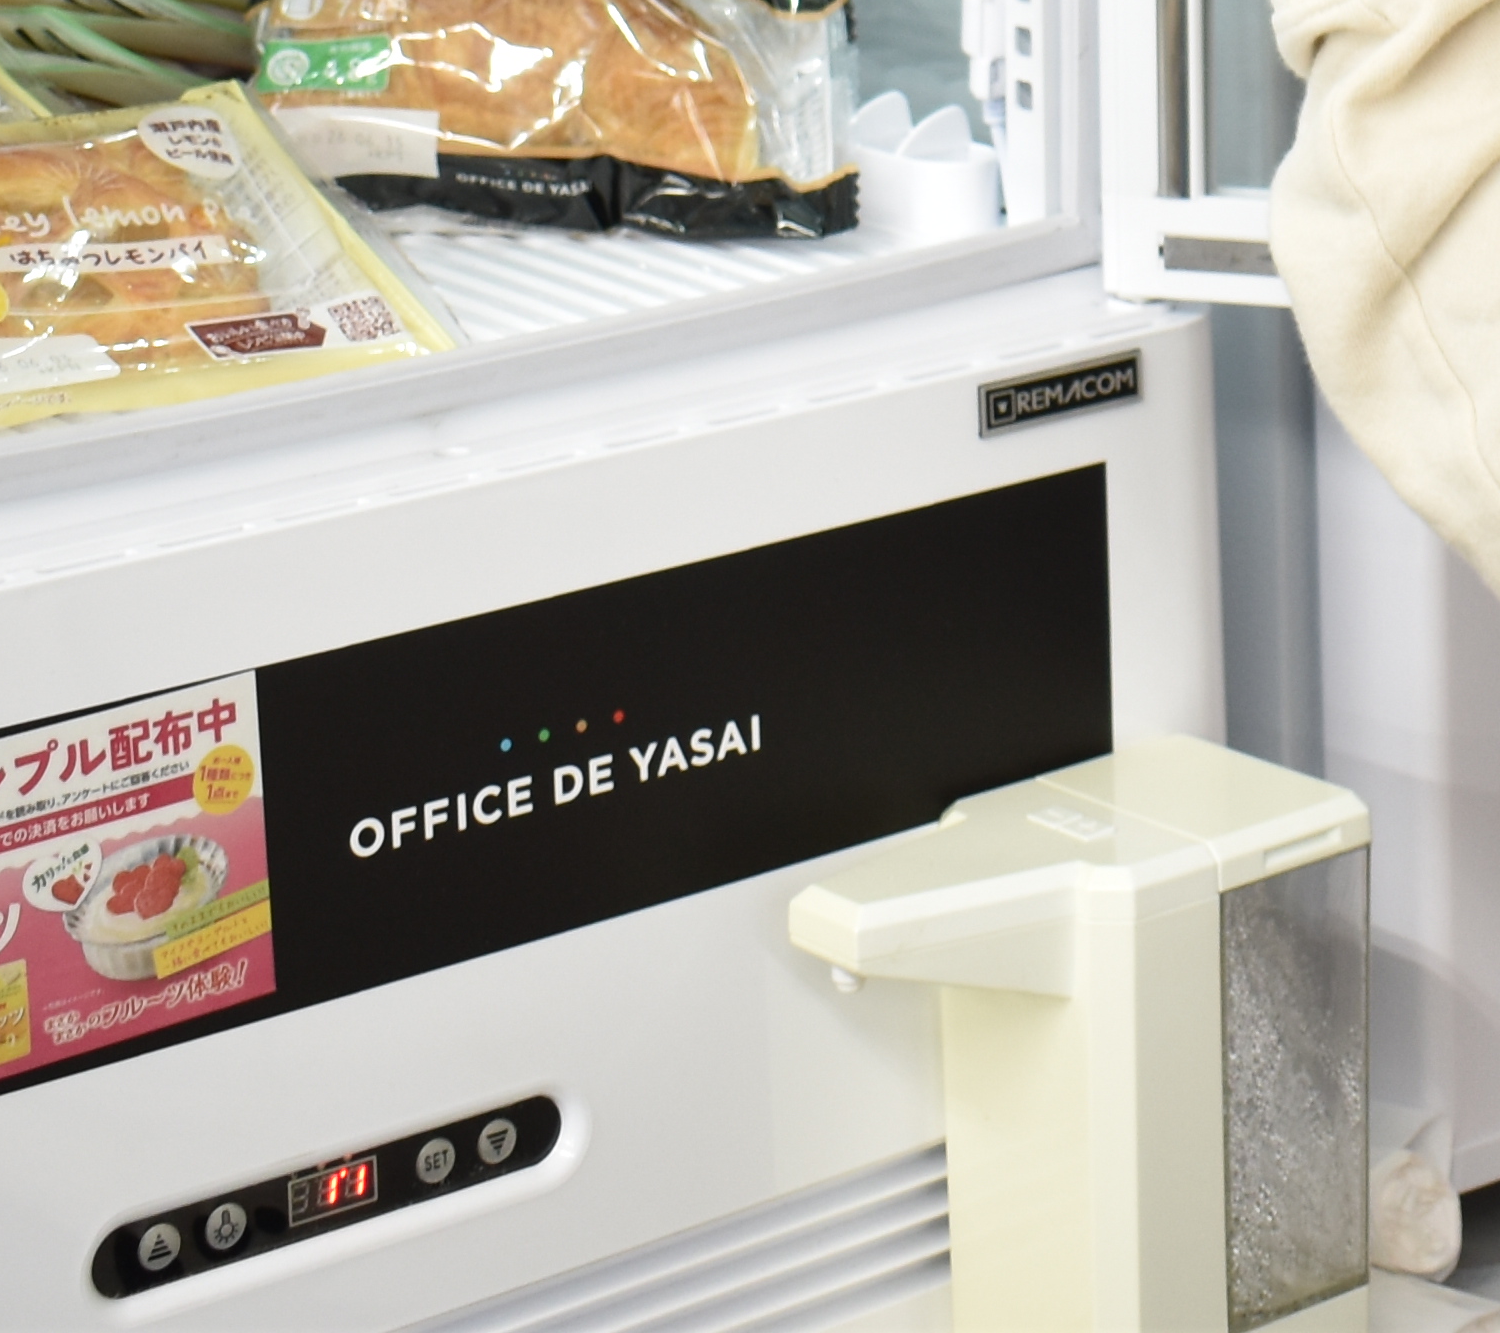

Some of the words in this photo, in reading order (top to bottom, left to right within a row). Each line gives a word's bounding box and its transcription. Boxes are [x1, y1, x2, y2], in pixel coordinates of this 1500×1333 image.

[454, 171, 518, 194] OFFICE
[520, 179, 547, 197] DE
[203, 195, 264, 229] pie
[1016, 366, 1136, 416] REMACOM
[349, 774, 535, 860] OFFICE
[553, 754, 615, 806] DE
[629, 713, 764, 783] YASAI
[423, 1147, 450, 1174] SET
